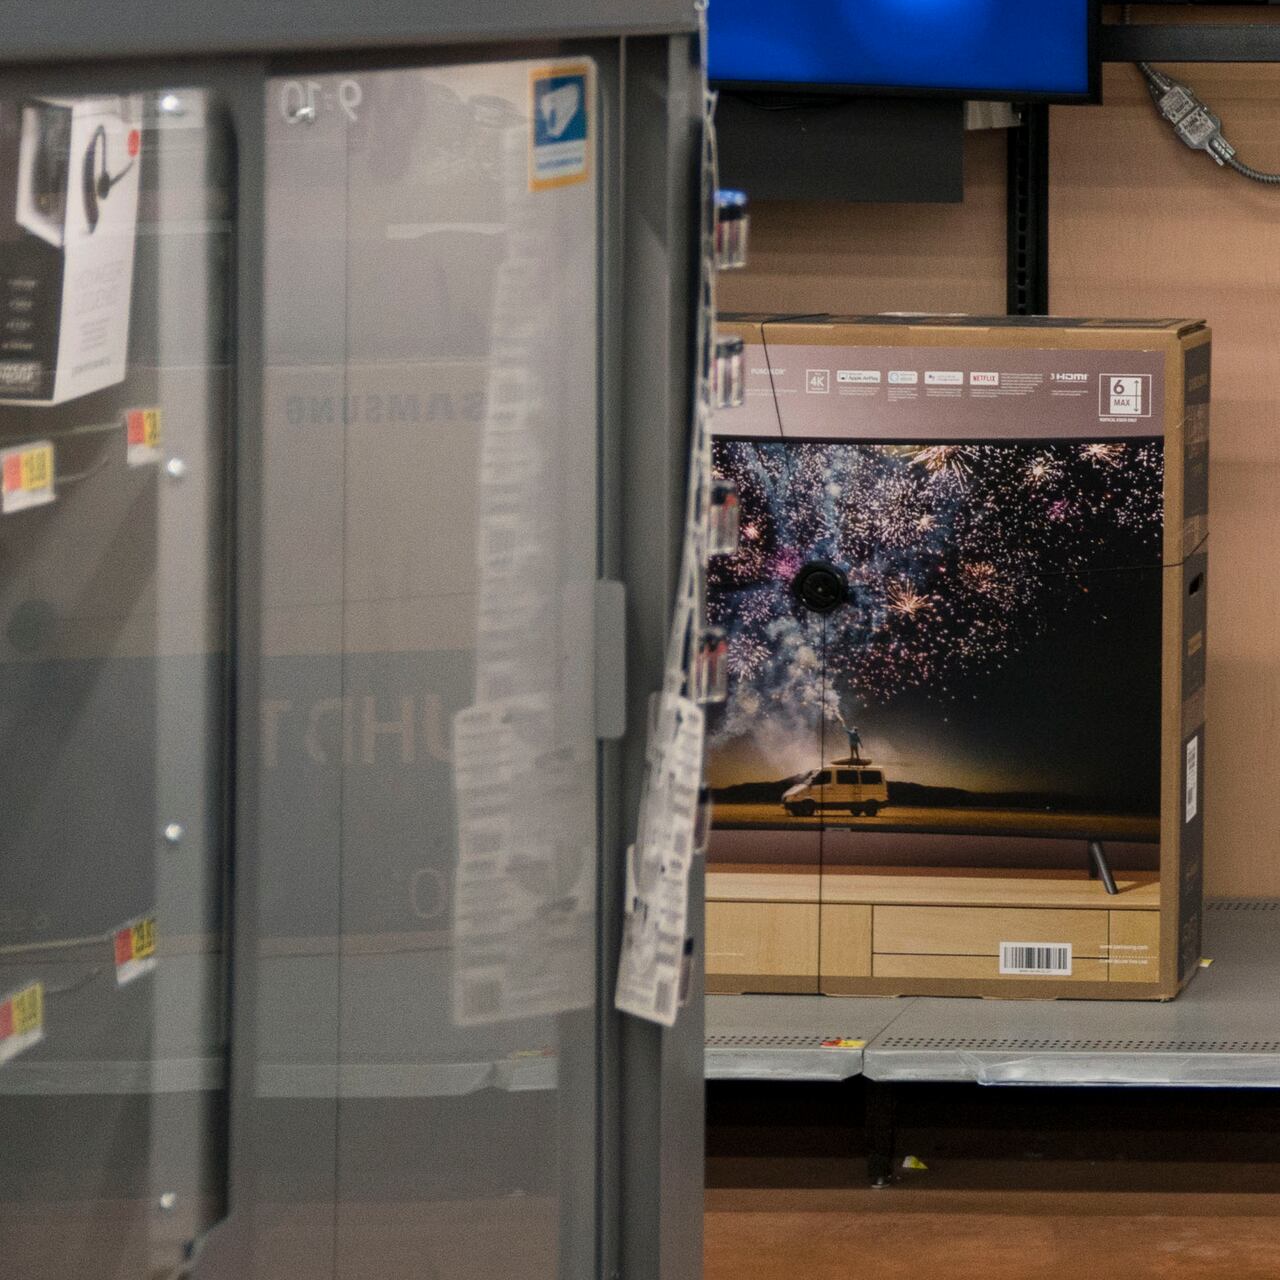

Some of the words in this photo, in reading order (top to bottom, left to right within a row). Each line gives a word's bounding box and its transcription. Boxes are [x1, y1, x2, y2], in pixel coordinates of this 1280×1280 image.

[810, 376, 824, 387] 4K
[1113, 379, 1125, 394] 6
[1113, 399, 1130, 407] MAX
